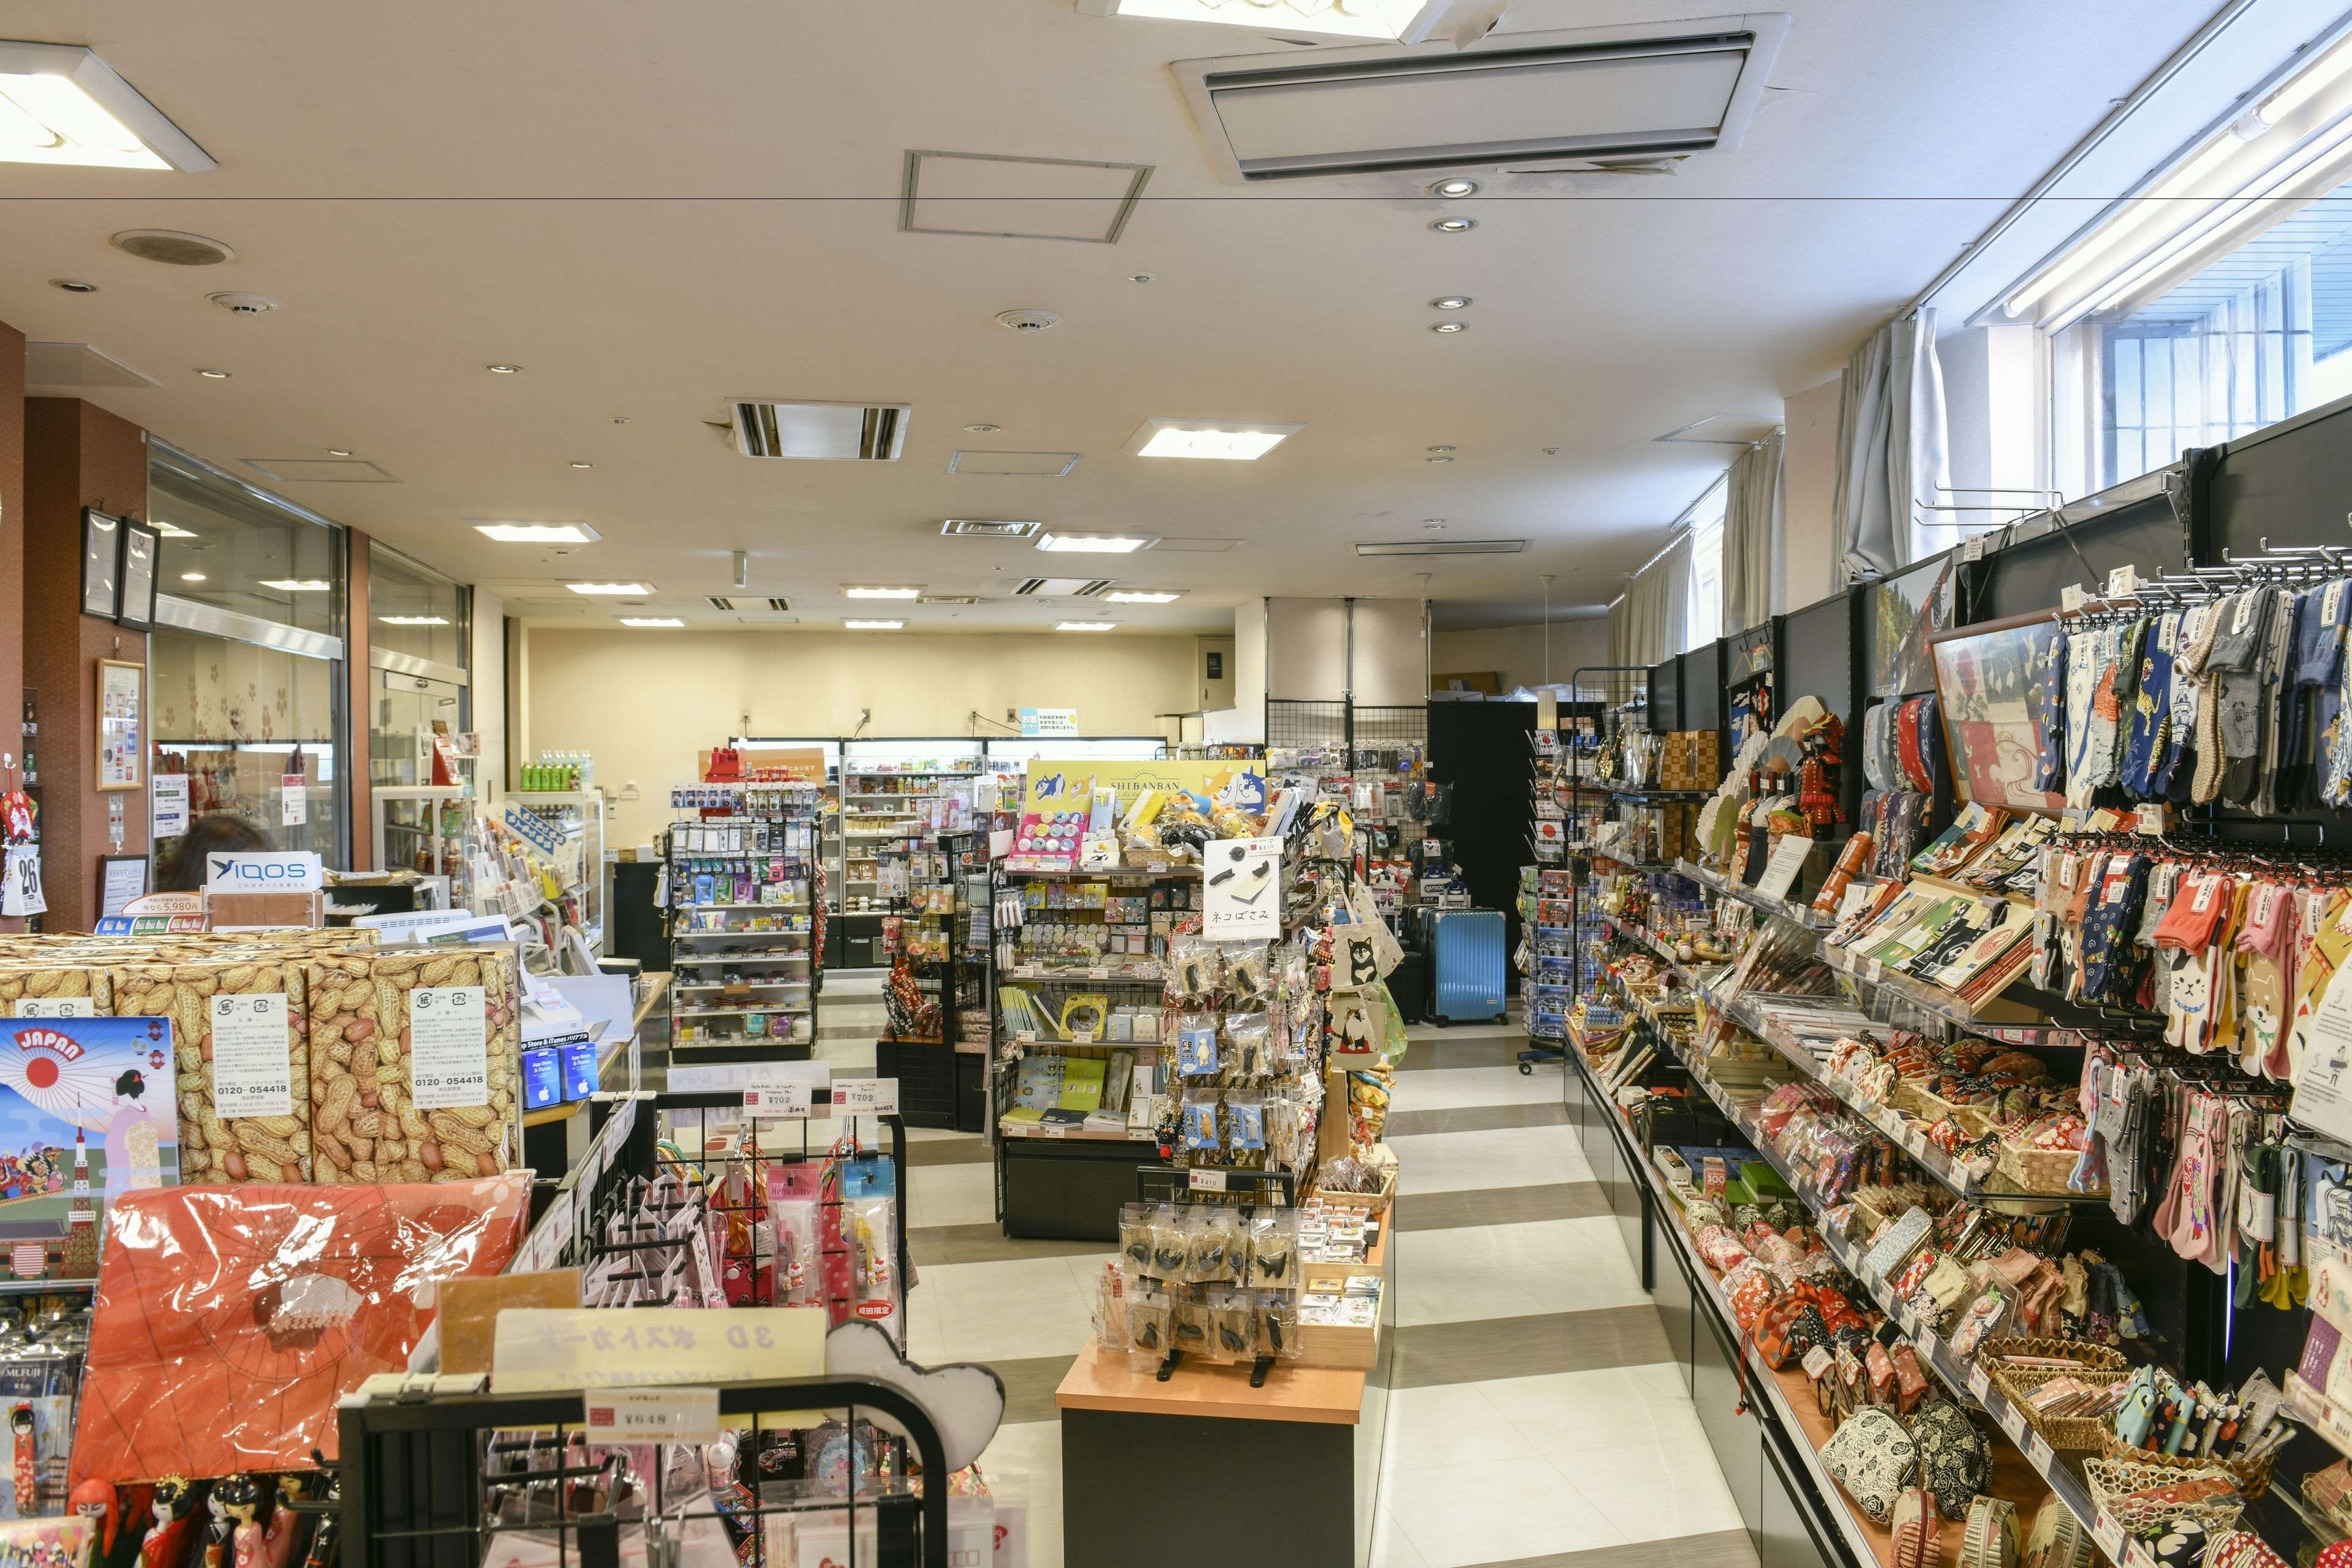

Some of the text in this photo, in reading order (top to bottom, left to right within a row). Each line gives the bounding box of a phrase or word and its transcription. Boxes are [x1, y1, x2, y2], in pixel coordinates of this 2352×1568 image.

[1022, 715, 1038, 724] お酒
[19, 859, 37, 894] 26
[235, 864, 306, 881] IQOS
[164, 902, 198, 911] 5,980円
[1212, 911, 1269, 924] ネコばさみ
[21, 1031, 80, 1059] JAPAN
[1200, 1178, 1216, 1186] ¥410
[1707, 1175, 1725, 1184] 300
[858, 1306, 889, 1315] 成田限定
[6, 1368, 41, 1378] Mt.FUJI
[625, 1414, 667, 1425] ¥648
